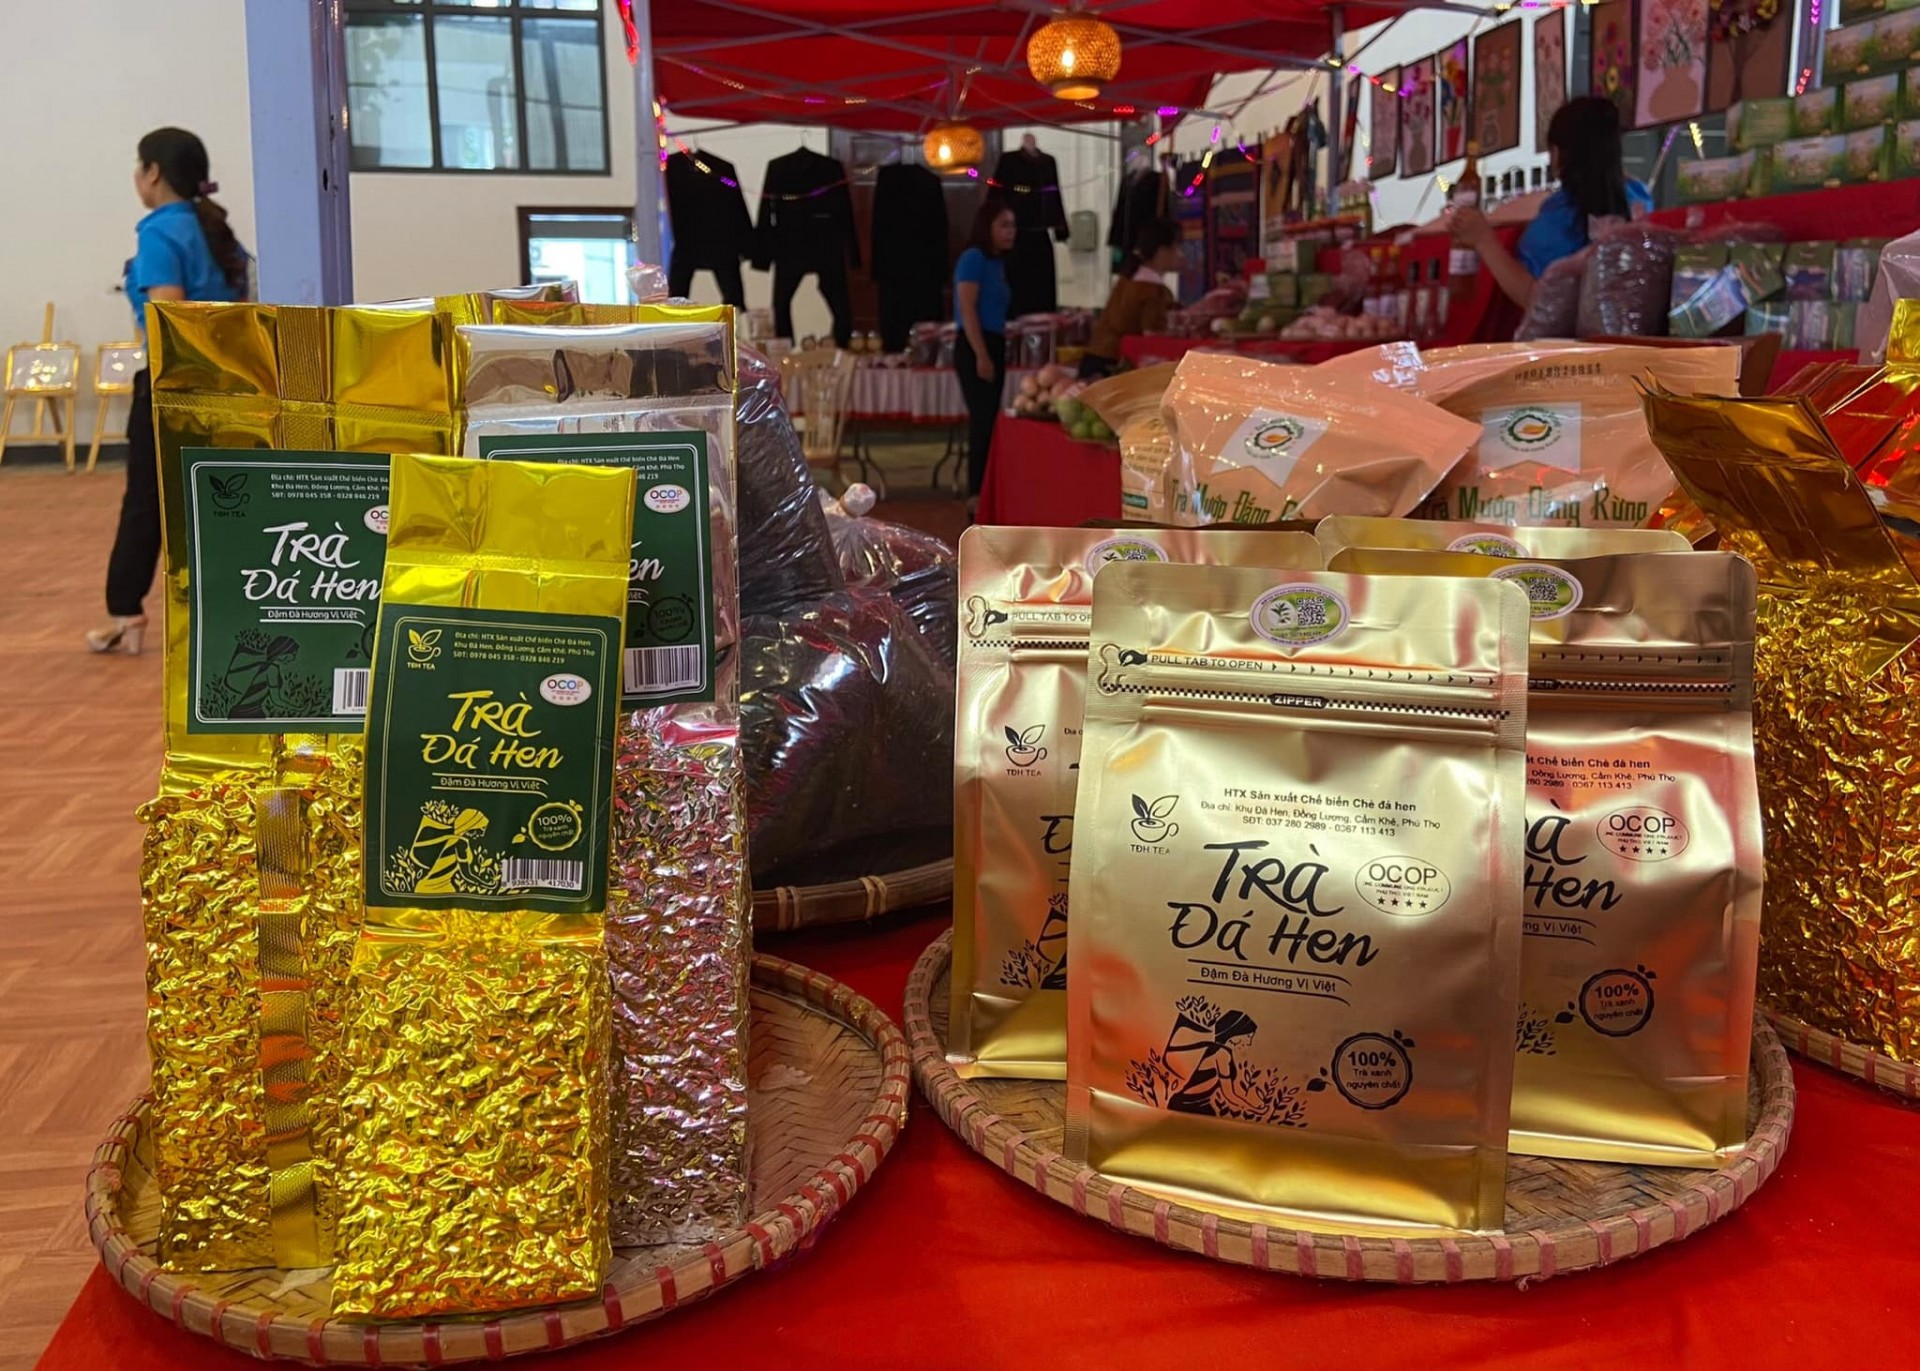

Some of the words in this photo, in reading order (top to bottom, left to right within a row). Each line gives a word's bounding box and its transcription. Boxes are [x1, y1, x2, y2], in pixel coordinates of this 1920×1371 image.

[650, 490, 683, 499] OCOP
[630, 558, 665, 581] en
[240, 569, 302, 604] Đá
[310, 570, 382, 603] Hen
[268, 610, 288, 620] Đậm
[288, 610, 300, 620] Đà
[301, 610, 330, 620] Hương
[330, 610, 340, 620] Vị
[340, 610, 358, 620] Việt
[1012, 612, 1037, 621] PULL
[1040, 612, 1062, 621] TAB
[1064, 612, 1077, 622] TO
[1151, 654, 1182, 665] PULL
[1184, 656, 1208, 666] TAB
[1210, 658, 1226, 668] TO
[1229, 660, 1264, 670] OPEN
[547, 679, 584, 690] OCOP
[1274, 696, 1322, 707] ZIPPER
[420, 734, 482, 769] Đá
[489, 738, 564, 770] Hen
[1537, 756, 1558, 766] Chế
[1562, 758, 1584, 767] biến
[1588, 758, 1610, 768] Chè
[1613, 759, 1626, 768] đá
[1630, 760, 1650, 768] hen
[440, 776, 462, 787] Đậm
[464, 778, 476, 787] Đà
[478, 778, 508, 790] Hương
[510, 780, 520, 790] Vị
[521, 781, 541, 790] Việt
[1543, 780, 1564, 788] 2989
[1616, 782, 1632, 790] 413
[1224, 788, 1246, 799] HTX
[1250, 789, 1272, 800] Sản
[1274, 792, 1298, 803] xuất
[1300, 792, 1322, 805] Chế
[1326, 796, 1349, 807] biến
[1352, 798, 1375, 810] Chè
[1378, 799, 1392, 810] đá
[1394, 800, 1416, 812] hen
[537, 814, 572, 826] 100%
[1242, 816, 1264, 825] SĐT:
[1265, 818, 1283, 826] 037
[1286, 819, 1302, 828] 280
[1304, 822, 1326, 831] 2989
[1334, 824, 1357, 833] 0367
[1360, 826, 1376, 835] 113
[1379, 828, 1396, 837] 413
[1609, 814, 1676, 834] OCOP
[1040, 816, 1074, 854] Đ
[1369, 863, 1437, 885] OCOP
[1524, 864, 1623, 910] Hen
[1167, 902, 1254, 960] Đá
[1268, 913, 1380, 967] Hen
[1543, 922, 1556, 932] Vị
[1559, 923, 1582, 934] Việt
[1200, 967, 1228, 982] Đậm
[1232, 970, 1250, 983] Đà
[1252, 973, 1292, 990] Hương
[1296, 977, 1311, 991] Vị
[1314, 978, 1336, 993] Việt
[1595, 983, 1639, 998] 100%
[1348, 1051, 1396, 1067] 100%
[1353, 1068, 1368, 1077] Trà
[1370, 1068, 1392, 1077] xanh
[1346, 1081, 1380, 1090] nguyên
[1382, 1080, 1400, 1089] chất
